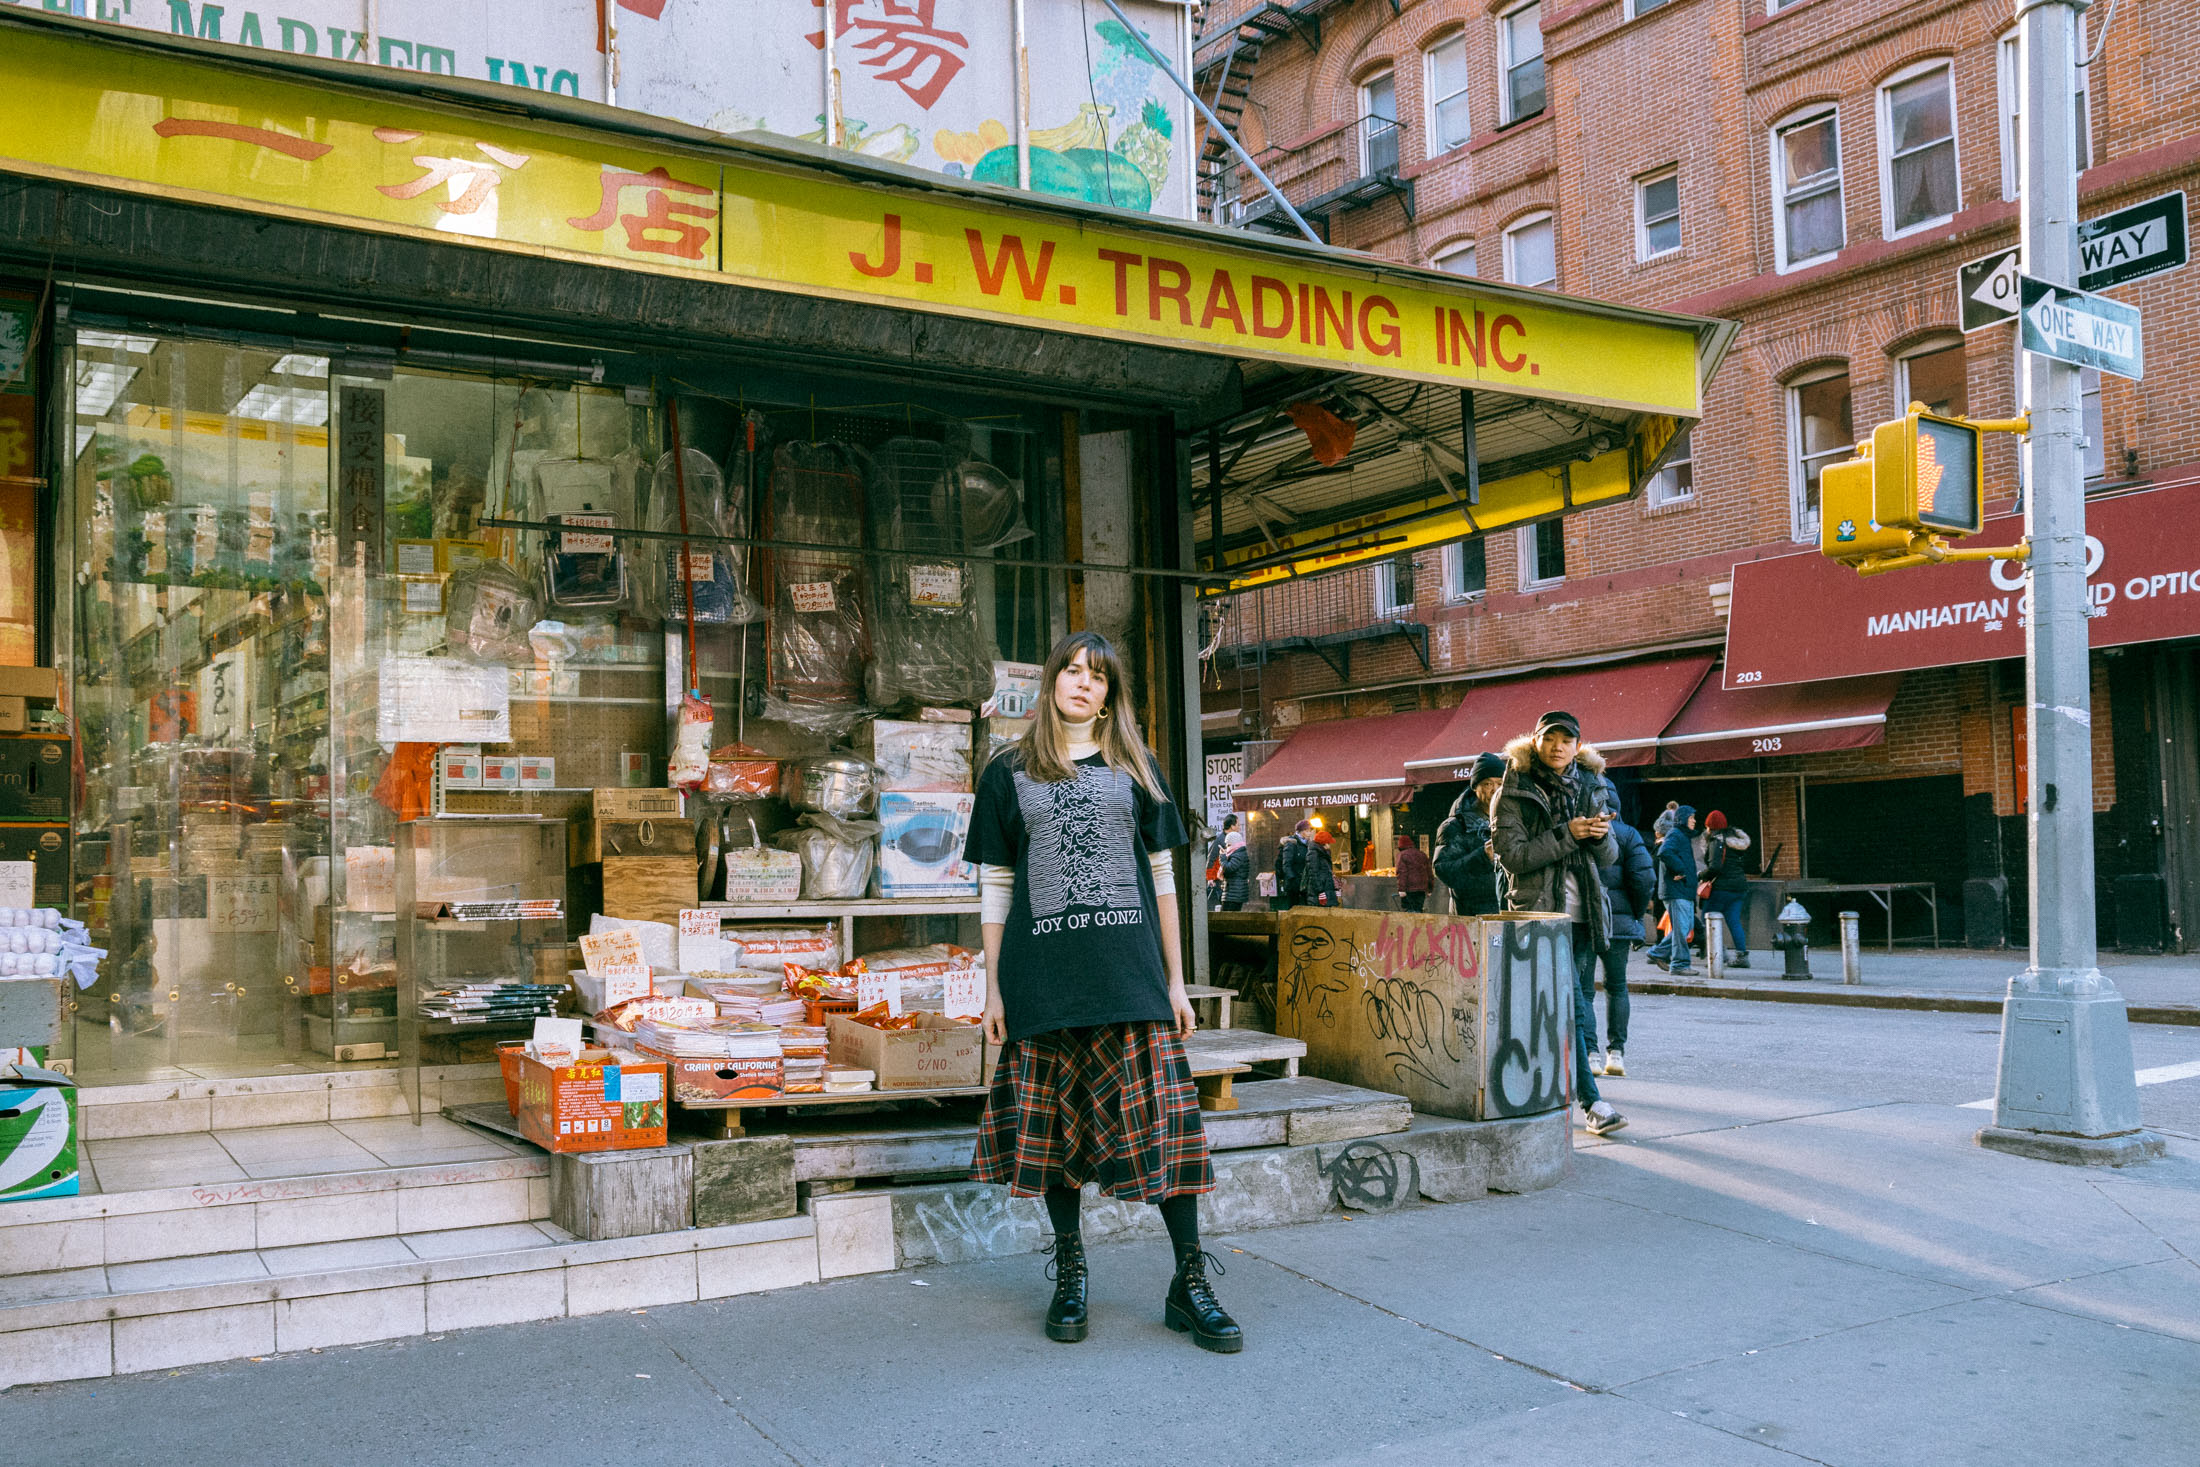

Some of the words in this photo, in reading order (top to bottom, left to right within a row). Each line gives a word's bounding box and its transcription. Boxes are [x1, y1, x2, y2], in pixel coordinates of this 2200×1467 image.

[2081, 224, 2152, 272] WAY
[848, 213, 934, 284] J.
[964, 227, 1077, 306] W.
[1098, 248, 1402, 358] TRADING
[1434, 306, 1541, 376] INC.
[2040, 304, 2076, 340] ONE
[2091, 319, 2126, 353] WAY
[1867, 597, 2009, 637] MANHATTAN
[1736, 670, 1763, 684] 203
[1752, 737, 1783, 753] 203
[1207, 757, 1242, 775] STORE
[1262, 799, 1281, 808] 145A
[1283, 797, 1306, 807] MOTT
[1307, 796, 1319, 806] ST.
[1320, 794, 1359, 804] TRADING
[1360, 792, 1378, 803] INC.
[1032, 916, 1064, 936] JOY
[1067, 913, 1091, 929] OF
[1094, 909, 1143, 926] GONZ!
[918, 1042, 932, 1053] DX
[684, 1063, 711, 1072] CRAIN
[713, 1062, 726, 1071] OF
[727, 1061, 777, 1071] CALIFORNIA
[917, 1058, 952, 1071] C/NO:
